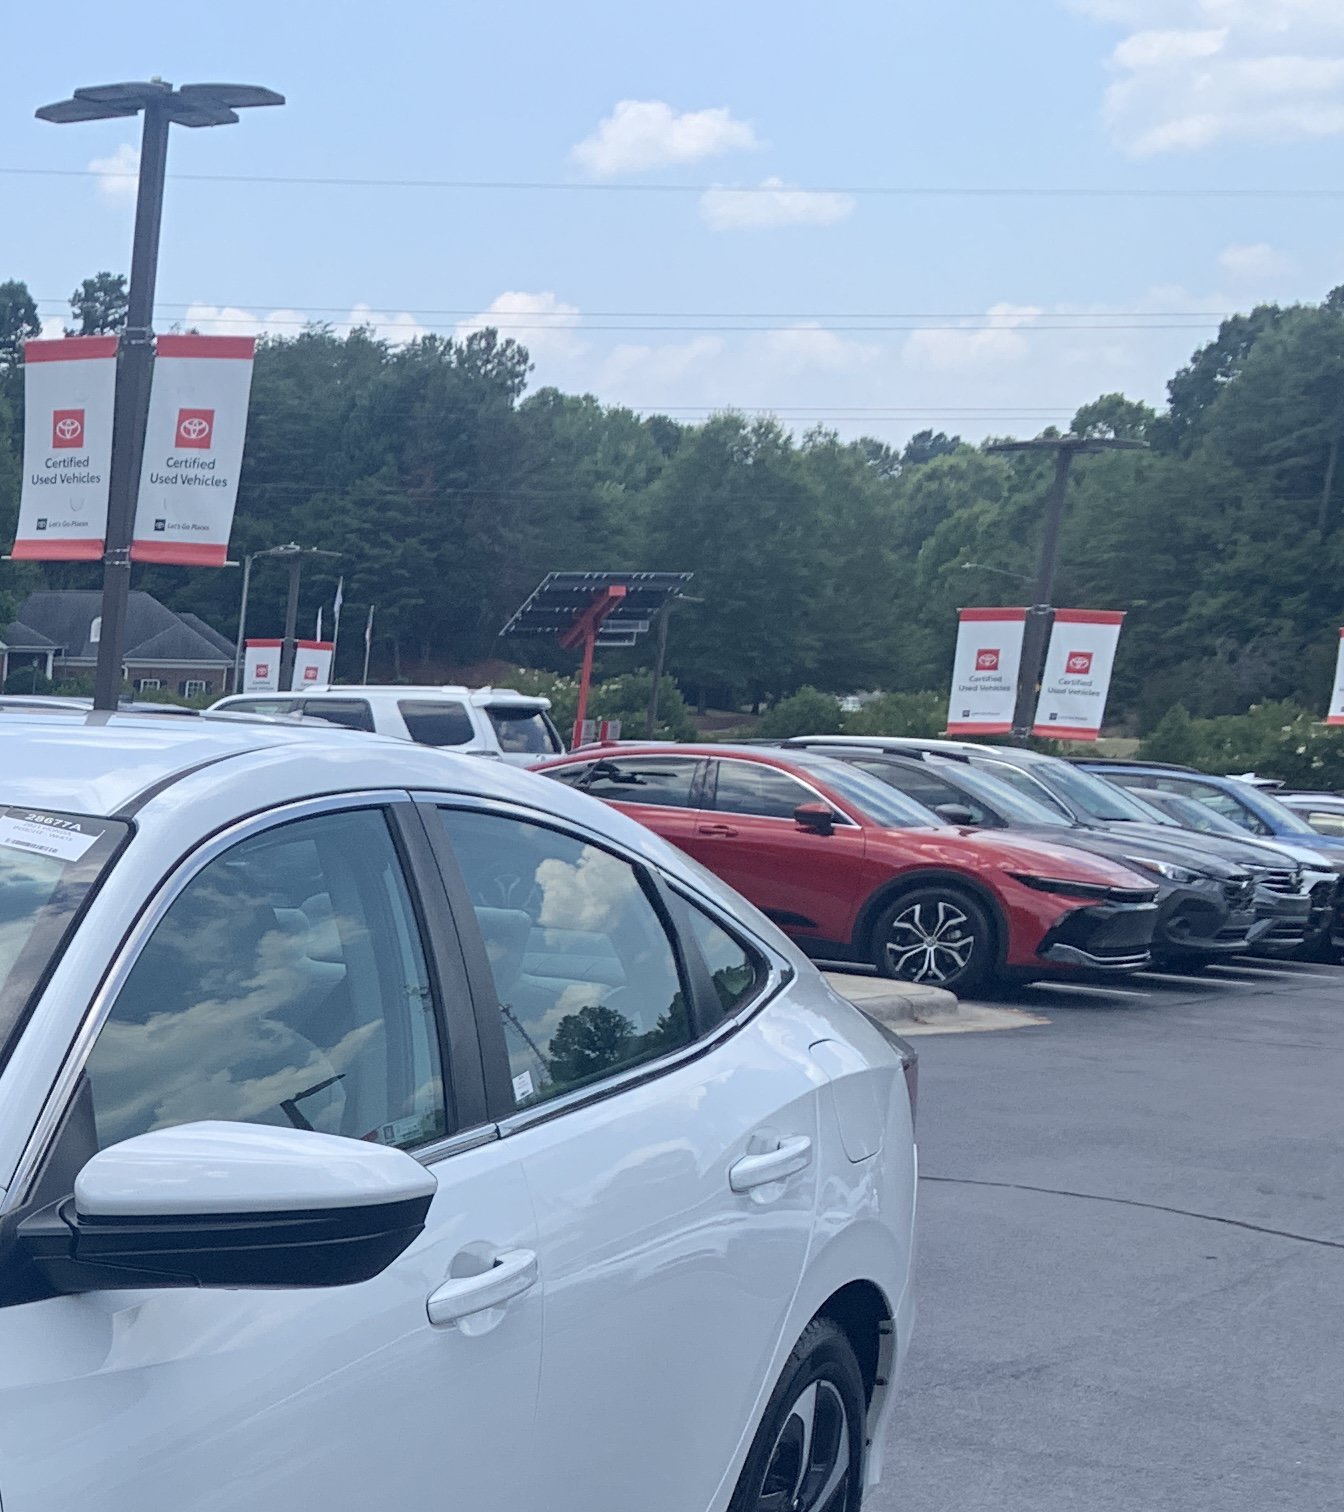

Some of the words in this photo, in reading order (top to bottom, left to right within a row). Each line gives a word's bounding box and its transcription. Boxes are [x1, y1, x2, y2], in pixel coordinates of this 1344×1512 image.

[45, 456, 90, 469] Certified
[166, 457, 216, 470] Certified
[31, 473, 58, 485] Used
[60, 472, 101, 484] Vehicles
[150, 472, 178, 485] Used
[180, 474, 228, 488] Vehicles
[25, 813, 81, 831] 28677A
